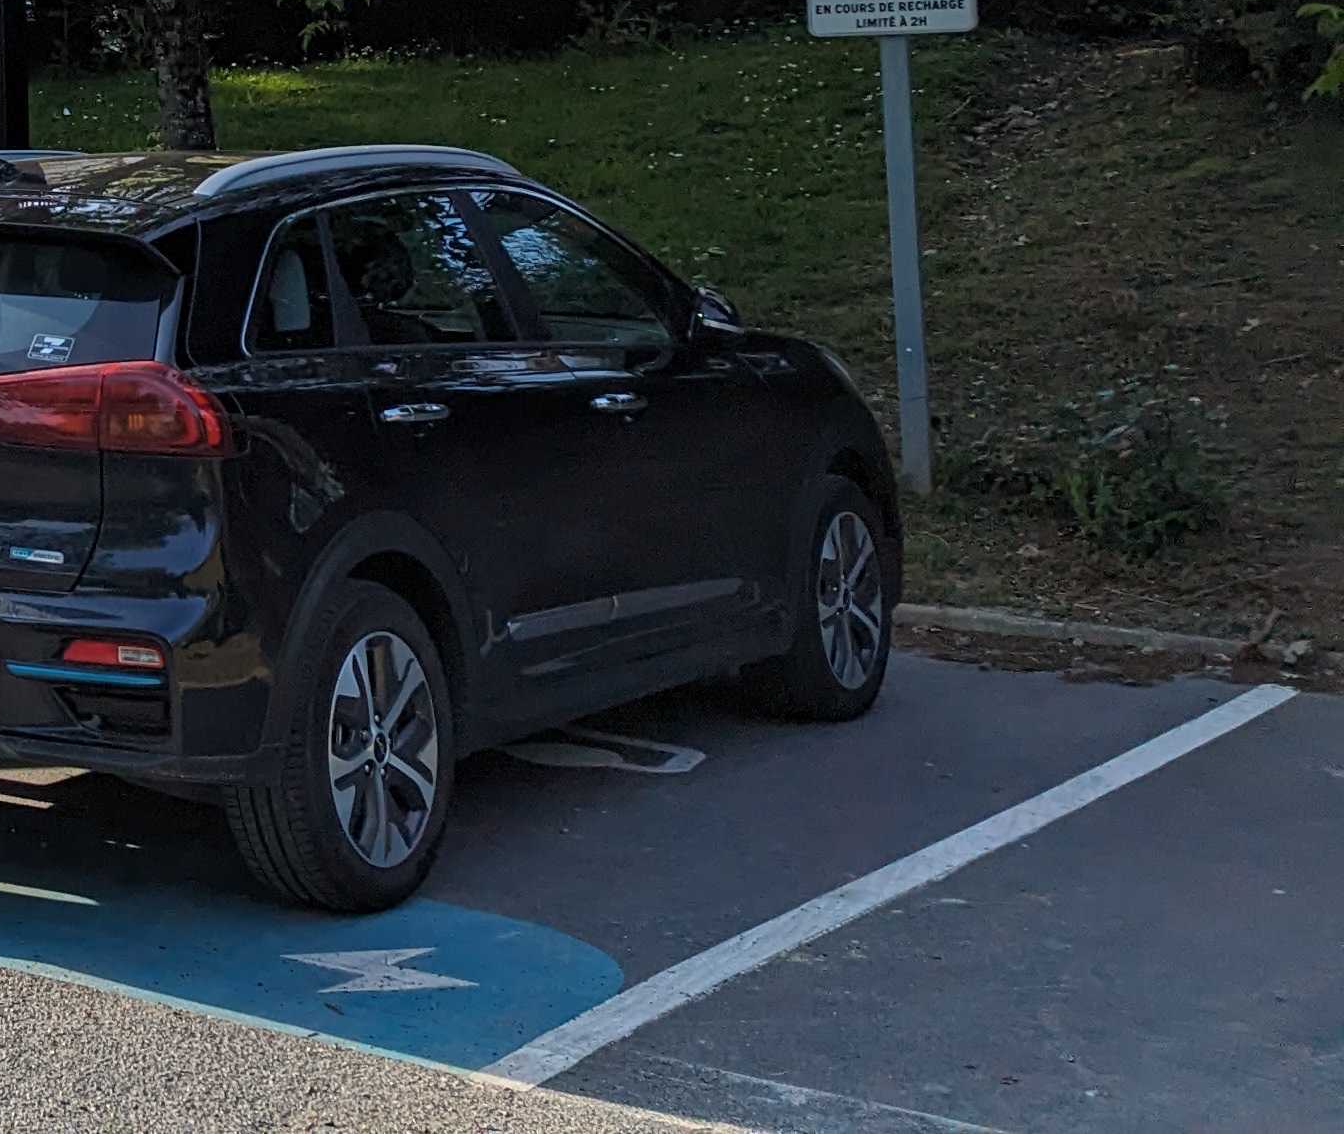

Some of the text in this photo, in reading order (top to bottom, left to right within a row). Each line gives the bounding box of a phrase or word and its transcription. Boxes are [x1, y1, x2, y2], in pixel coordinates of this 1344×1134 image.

[816, 0, 965, 14] EN COURS DE RECHARGE
[856, 16, 927, 28] LIMITÉ À 2H
